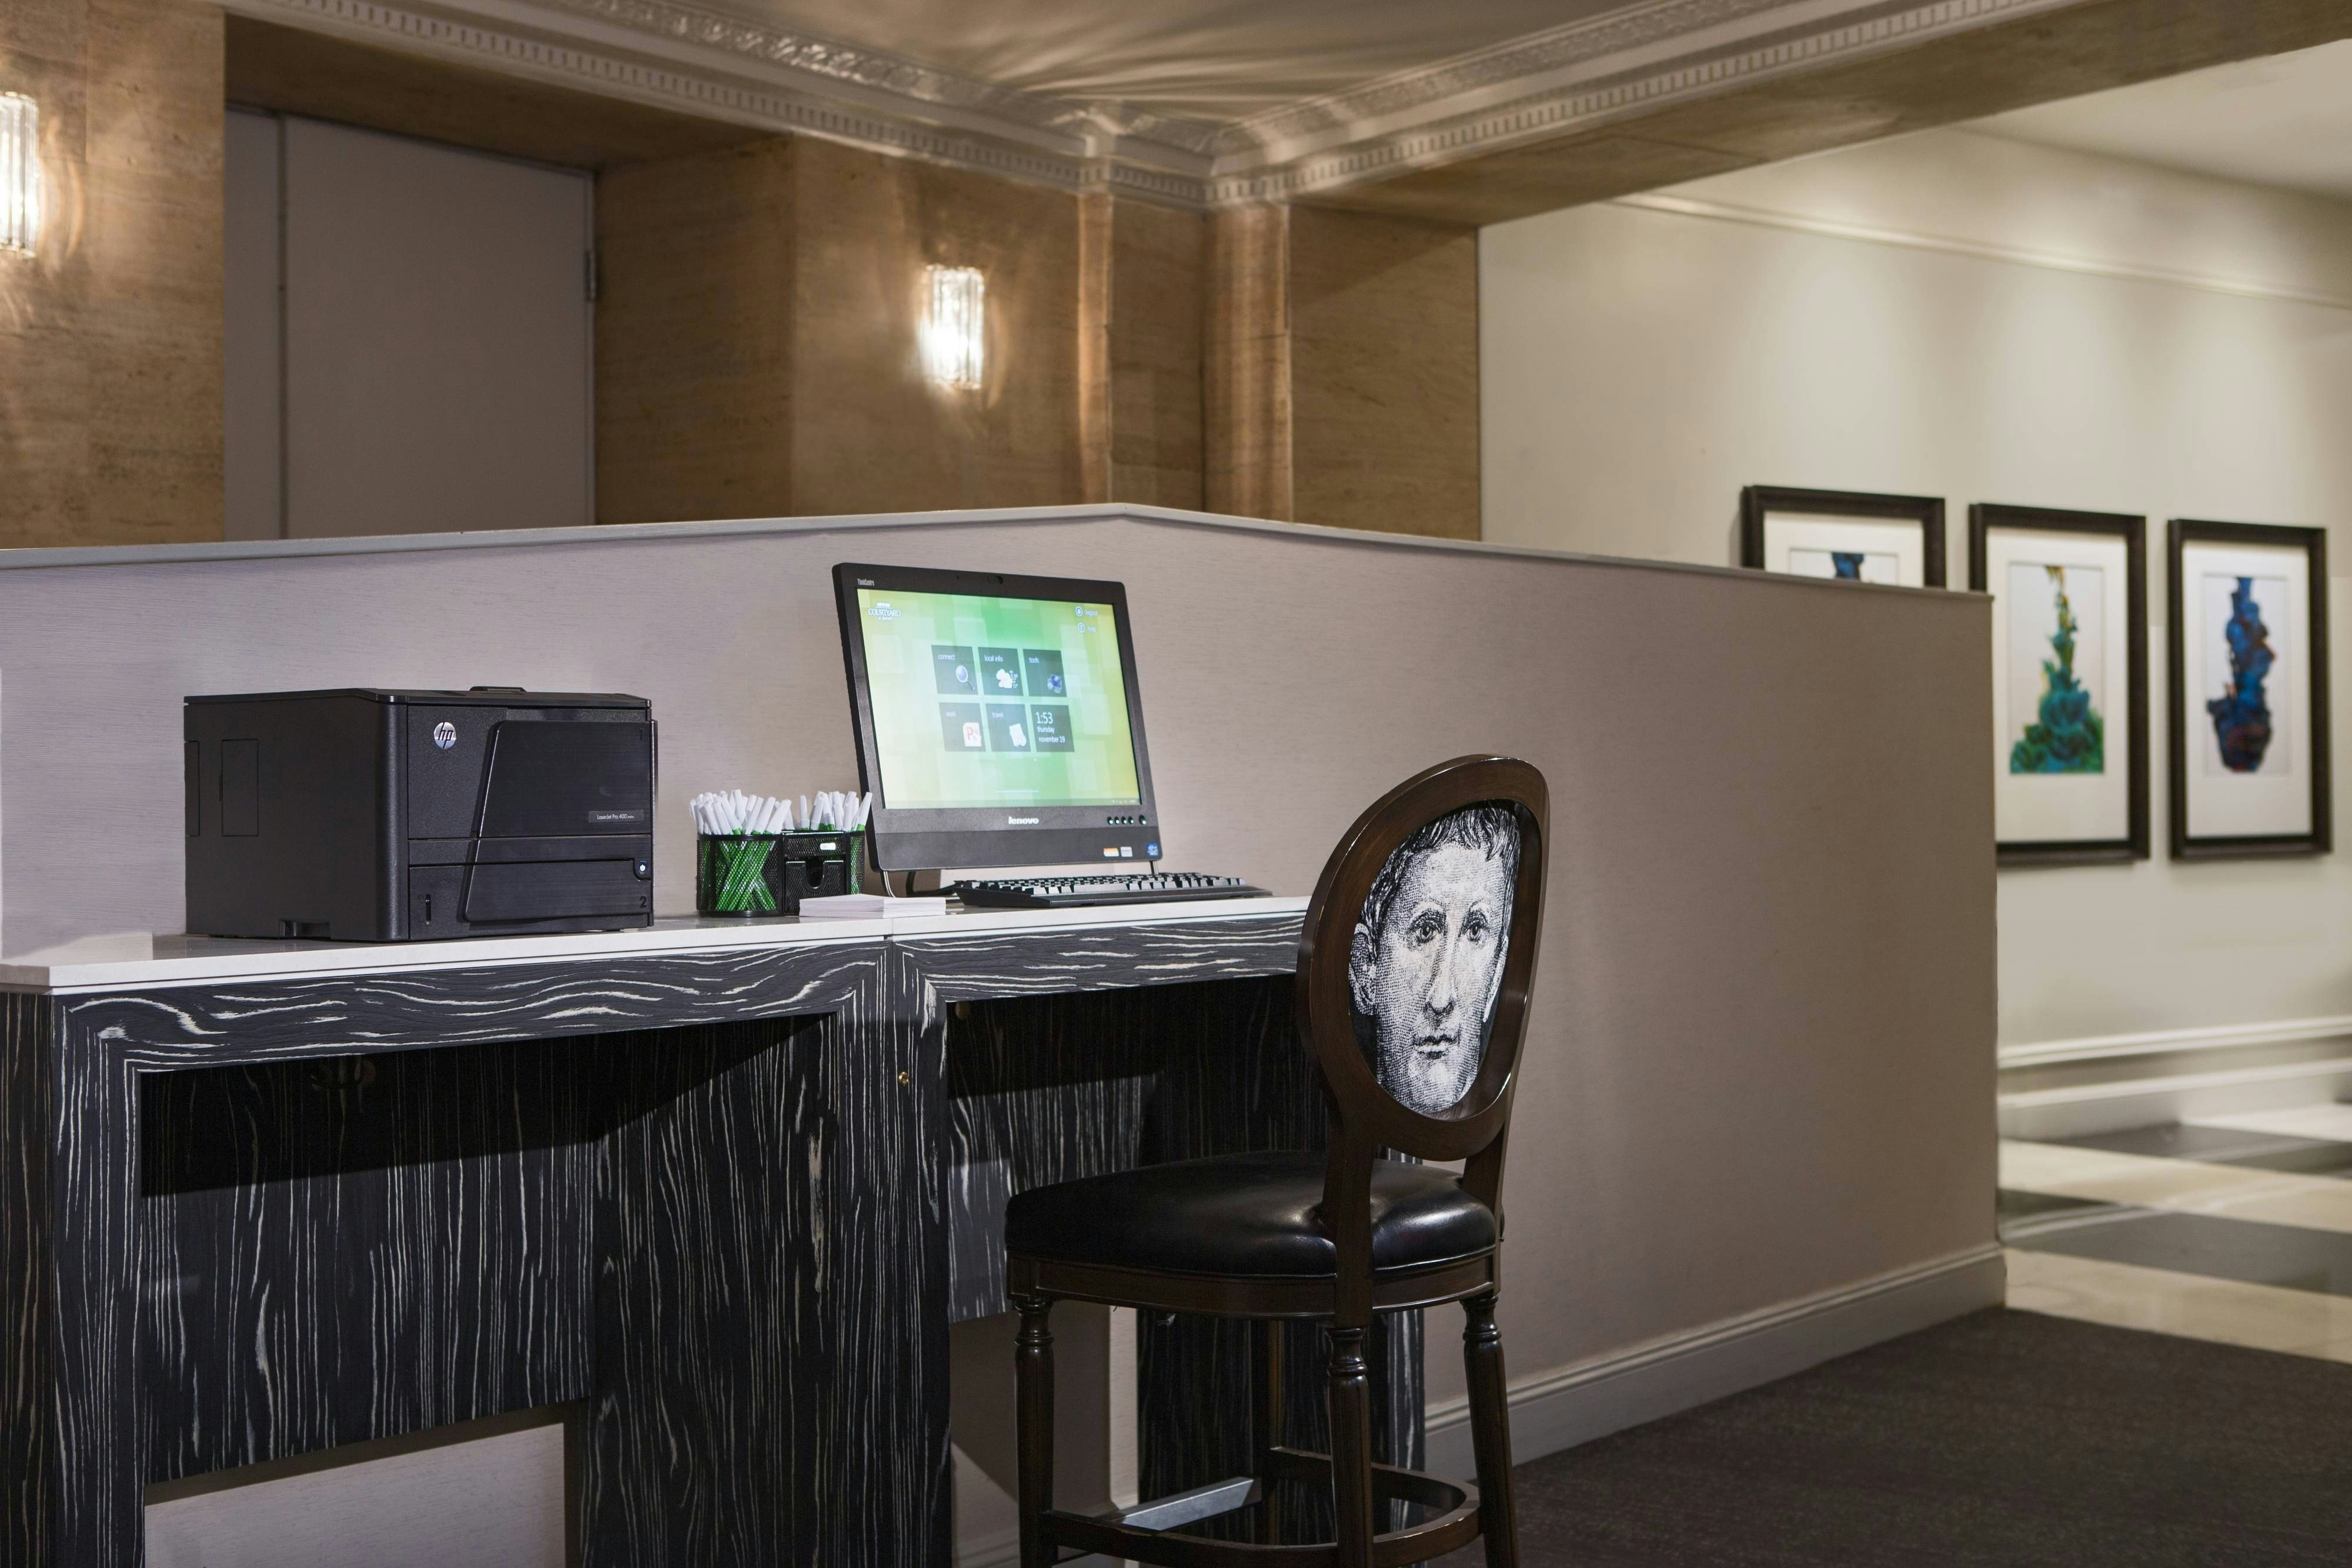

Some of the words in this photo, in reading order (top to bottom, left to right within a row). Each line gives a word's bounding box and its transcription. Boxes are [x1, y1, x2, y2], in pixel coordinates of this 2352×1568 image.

[868, 608, 901, 617] COURTYARD
[1035, 711, 1054, 724] 1:53
[1037, 726, 1055, 734] thursday
[1059, 735, 1065, 743] 19
[1008, 816, 1040, 824] lenovo
[639, 895, 647, 908] 2
